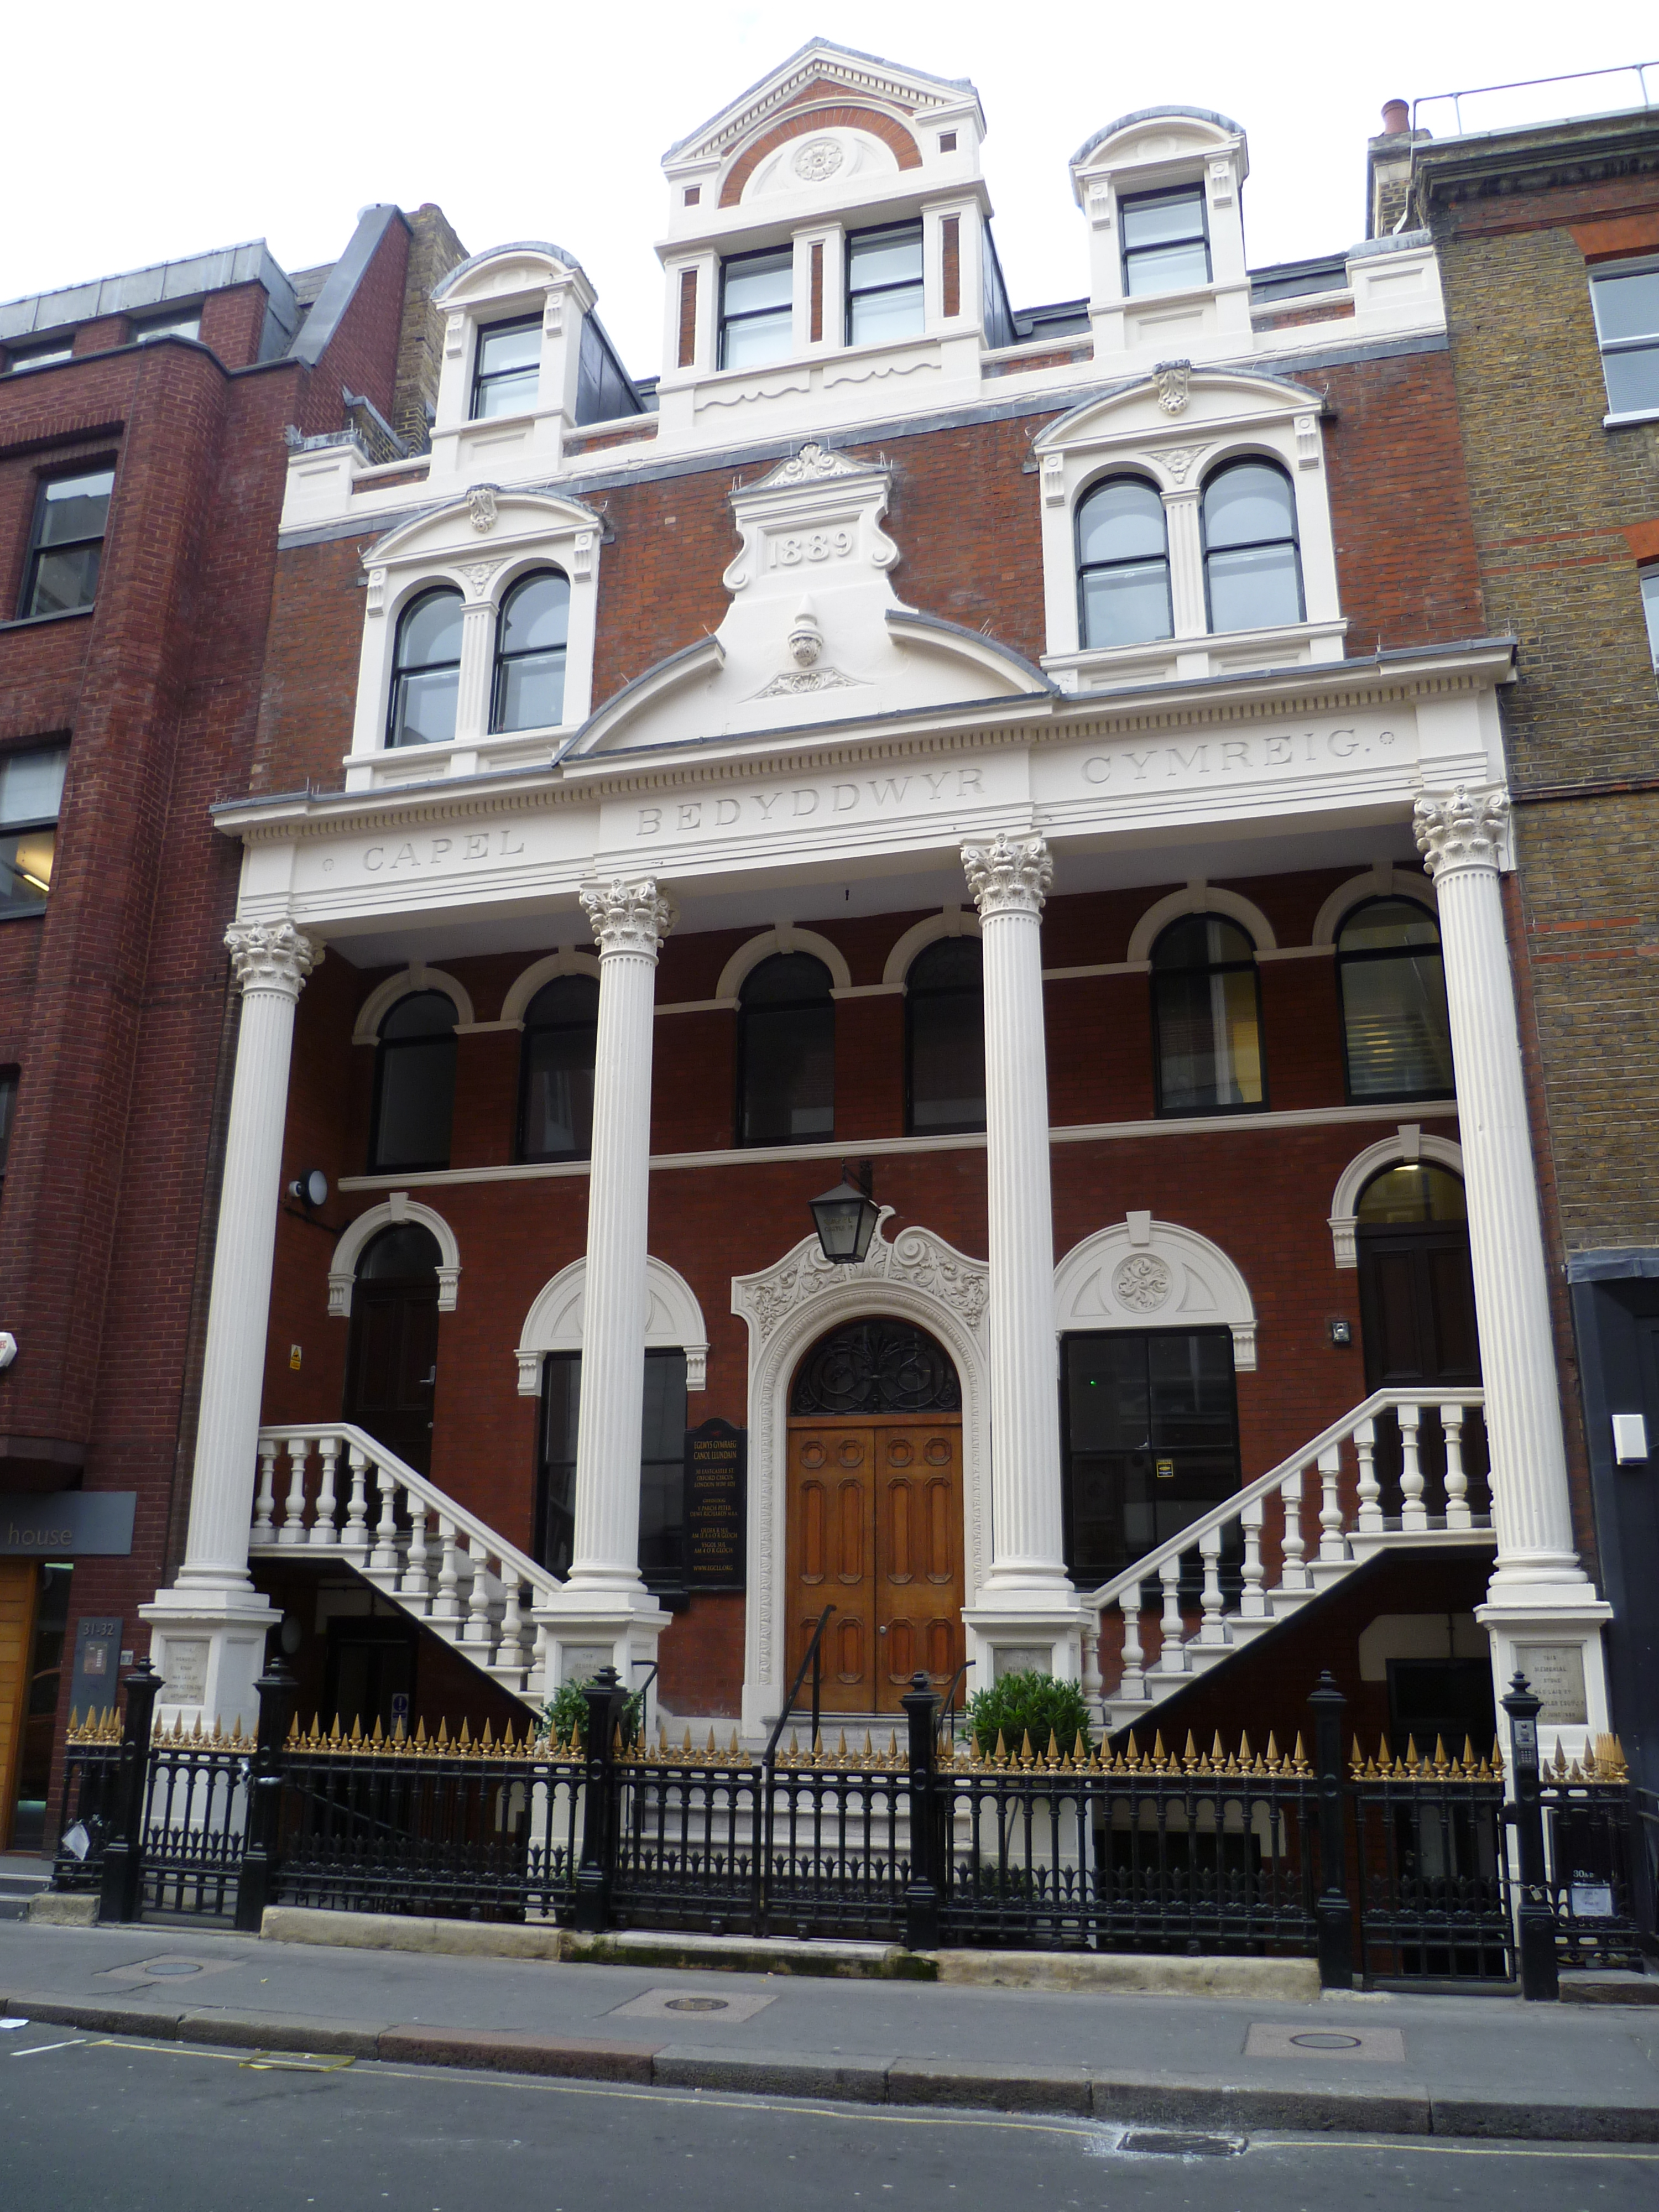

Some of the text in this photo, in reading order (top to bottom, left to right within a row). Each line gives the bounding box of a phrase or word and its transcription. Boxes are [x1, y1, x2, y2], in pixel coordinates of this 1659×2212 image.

[769, 530, 854, 568] 1889
[362, 728, 1371, 872] CAPEL BEDYDDWYR CYMREIG.
[694, 1440, 737, 1449] EGLWYS GYMRAEG
[693, 1451, 737, 1460] CANOL LLUNDAIN
[8, 1522, 72, 1547] house
[83, 1623, 114, 1636] 31-32
